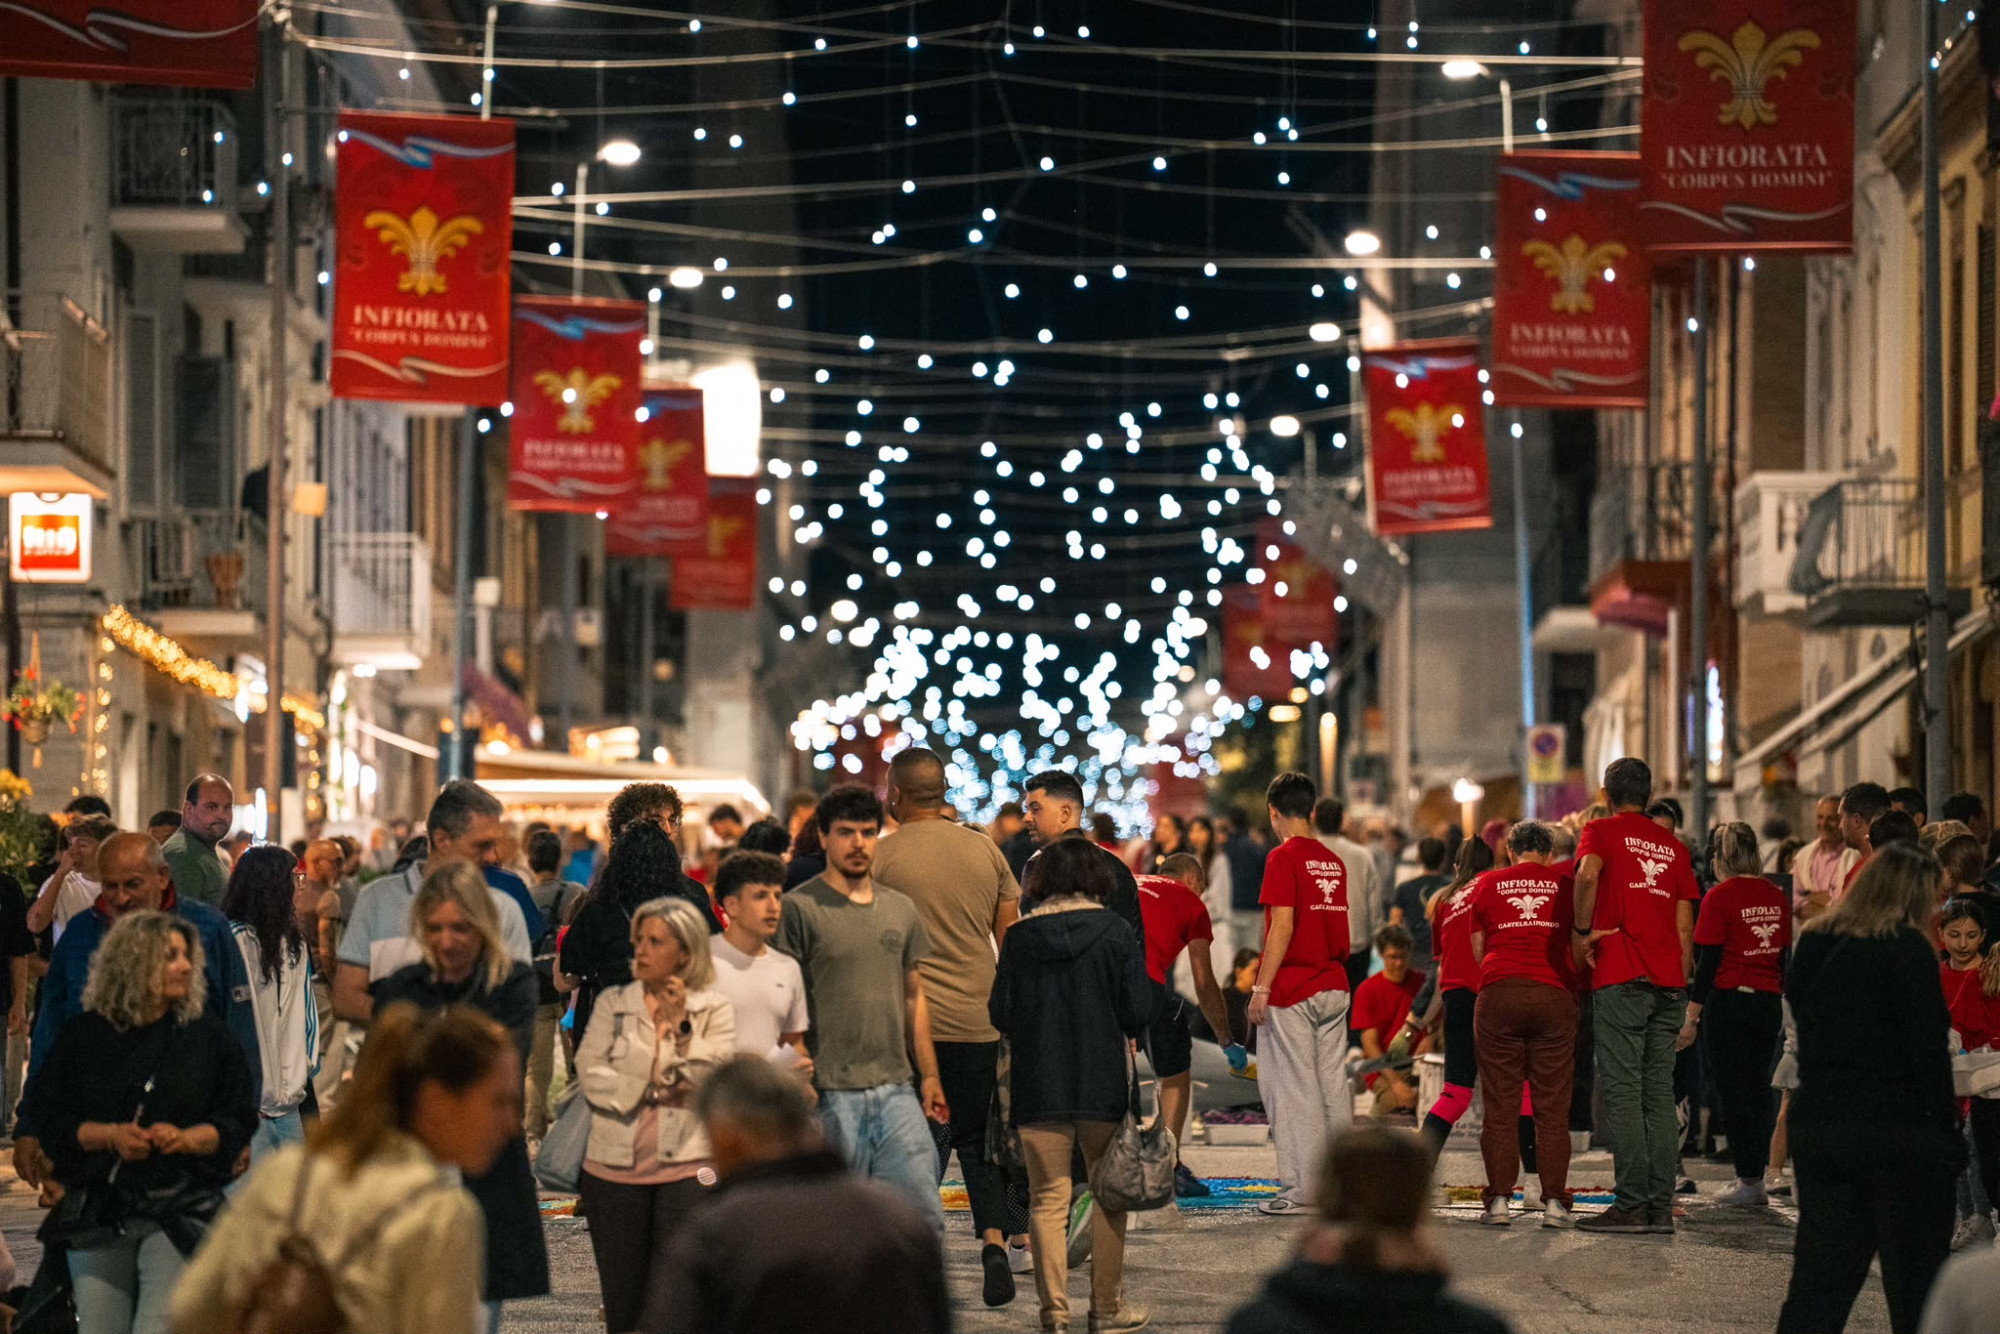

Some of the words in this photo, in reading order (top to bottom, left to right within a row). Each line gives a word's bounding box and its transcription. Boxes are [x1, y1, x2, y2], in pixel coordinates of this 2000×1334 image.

[1666, 143, 1828, 169] INFIORATA
[353, 304, 489, 332] INFIORATA
[1625, 836, 1676, 858] INFIORATA
[1496, 879, 1559, 891] INFIORATA
[1497, 920, 1560, 930] CASTELRAIMONDO
